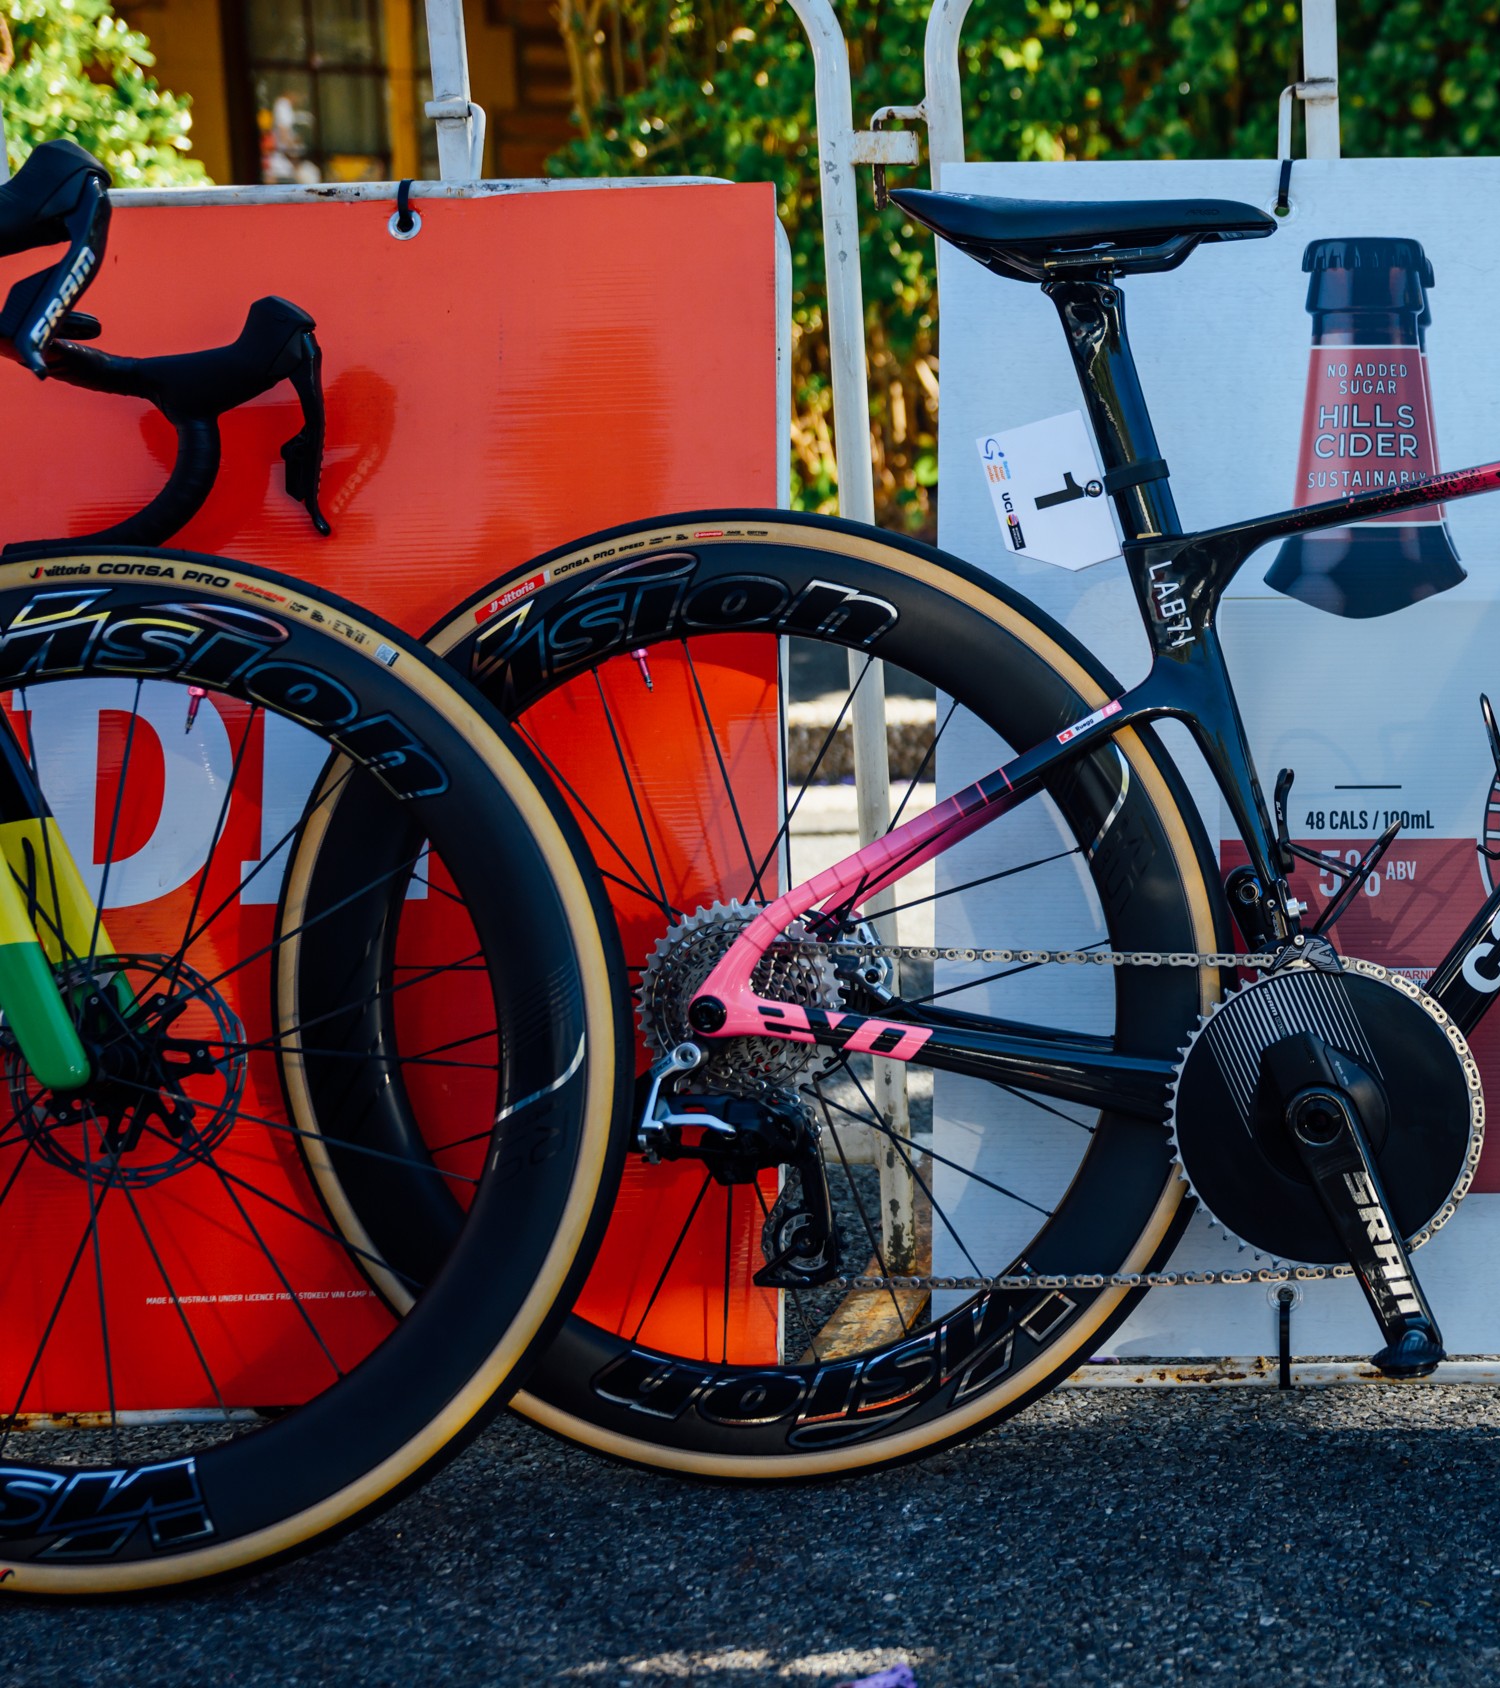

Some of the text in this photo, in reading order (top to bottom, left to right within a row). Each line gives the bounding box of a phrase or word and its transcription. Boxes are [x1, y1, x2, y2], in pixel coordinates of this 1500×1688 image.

[30, 246, 96, 350] SRAM
[1327, 363, 1408, 377] NO ADDED
[1339, 380, 1397, 395] SUGAR
[1319, 404, 1415, 429] HILLS
[1314, 433, 1418, 458] CIDER
[1001, 492, 1014, 513] UCI
[1034, 472, 1086, 511] 1
[44, 563, 231, 588] vittoria CORSA PRO
[498, 541, 645, 607] vittoria CORSA PRO SPEED
[1149, 560, 1196, 647] LAB71
[1306, 811, 1325, 830] 48
[1329, 810, 1369, 830] CALS
[1383, 809, 1435, 830] 100mL
[1385, 861, 1416, 880] ABV
[1261, 987, 1278, 1017] SRAM
[1343, 1171, 1431, 1328] SRAM
[146, 1297, 168, 1305] MADE
[178, 1295, 217, 1304] AUSTRALIA
[218, 1294, 244, 1303] UNDER
[245, 1293, 275, 1302] LICENCE
[299, 1291, 330, 1300] STOKELY
[331, 1290, 346, 1299] VAN
[347, 1290, 367, 1298] CAMP
